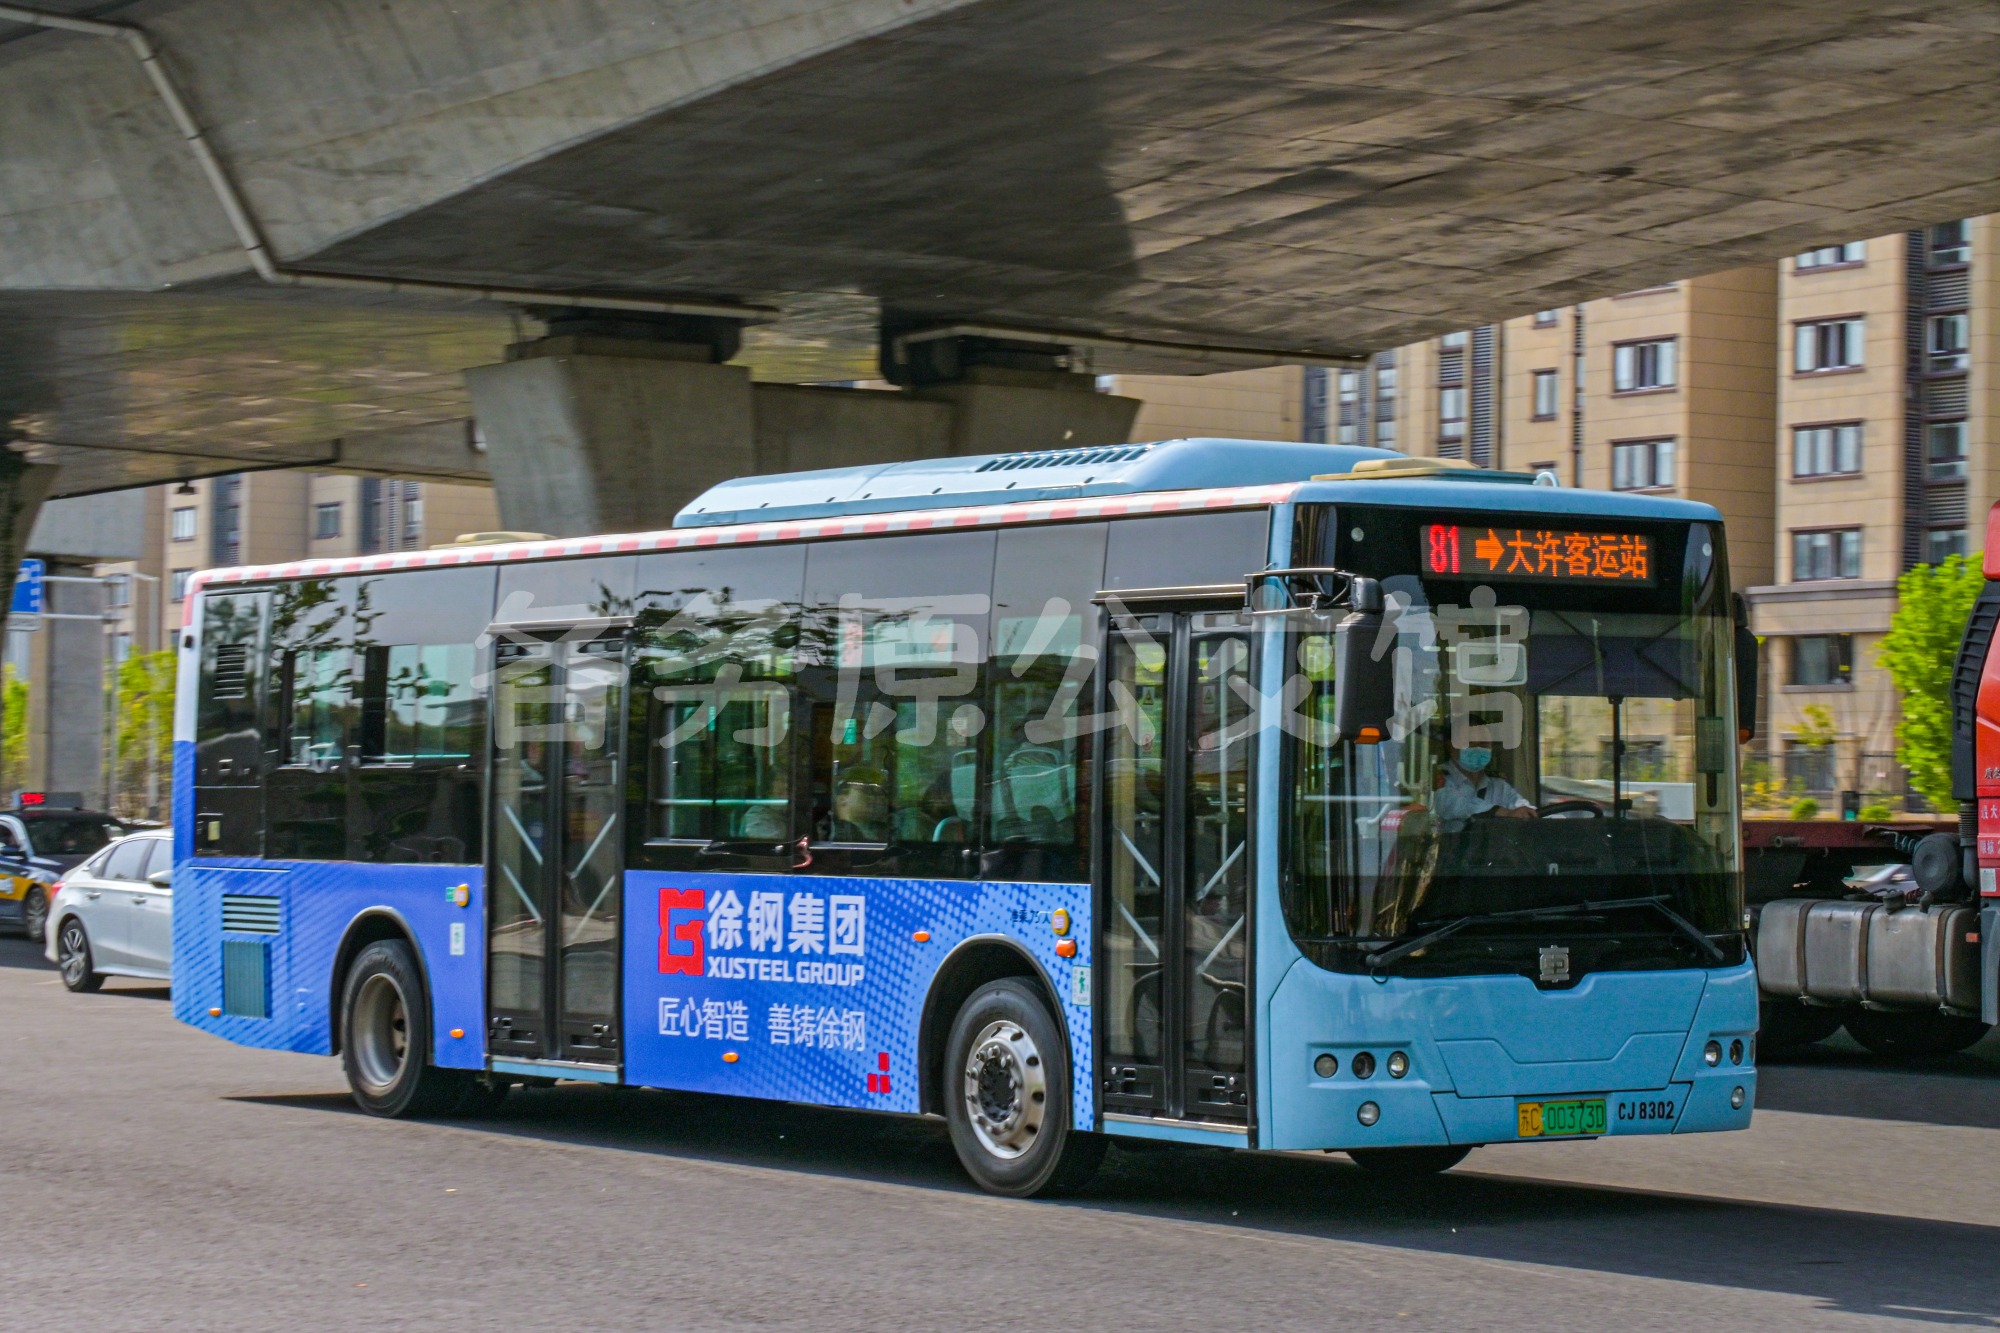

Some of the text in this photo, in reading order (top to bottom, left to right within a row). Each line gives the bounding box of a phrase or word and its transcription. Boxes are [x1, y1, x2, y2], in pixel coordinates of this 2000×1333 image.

[1429, 525, 1459, 573] 81
[1507, 529, 1648, 578] 大许客运站
[707, 889, 866, 957] 徐钢集团
[707, 956, 865, 987] XUSTEEL GROUP
[658, 997, 866, 1052] 匠心智造 善铸徐钢
